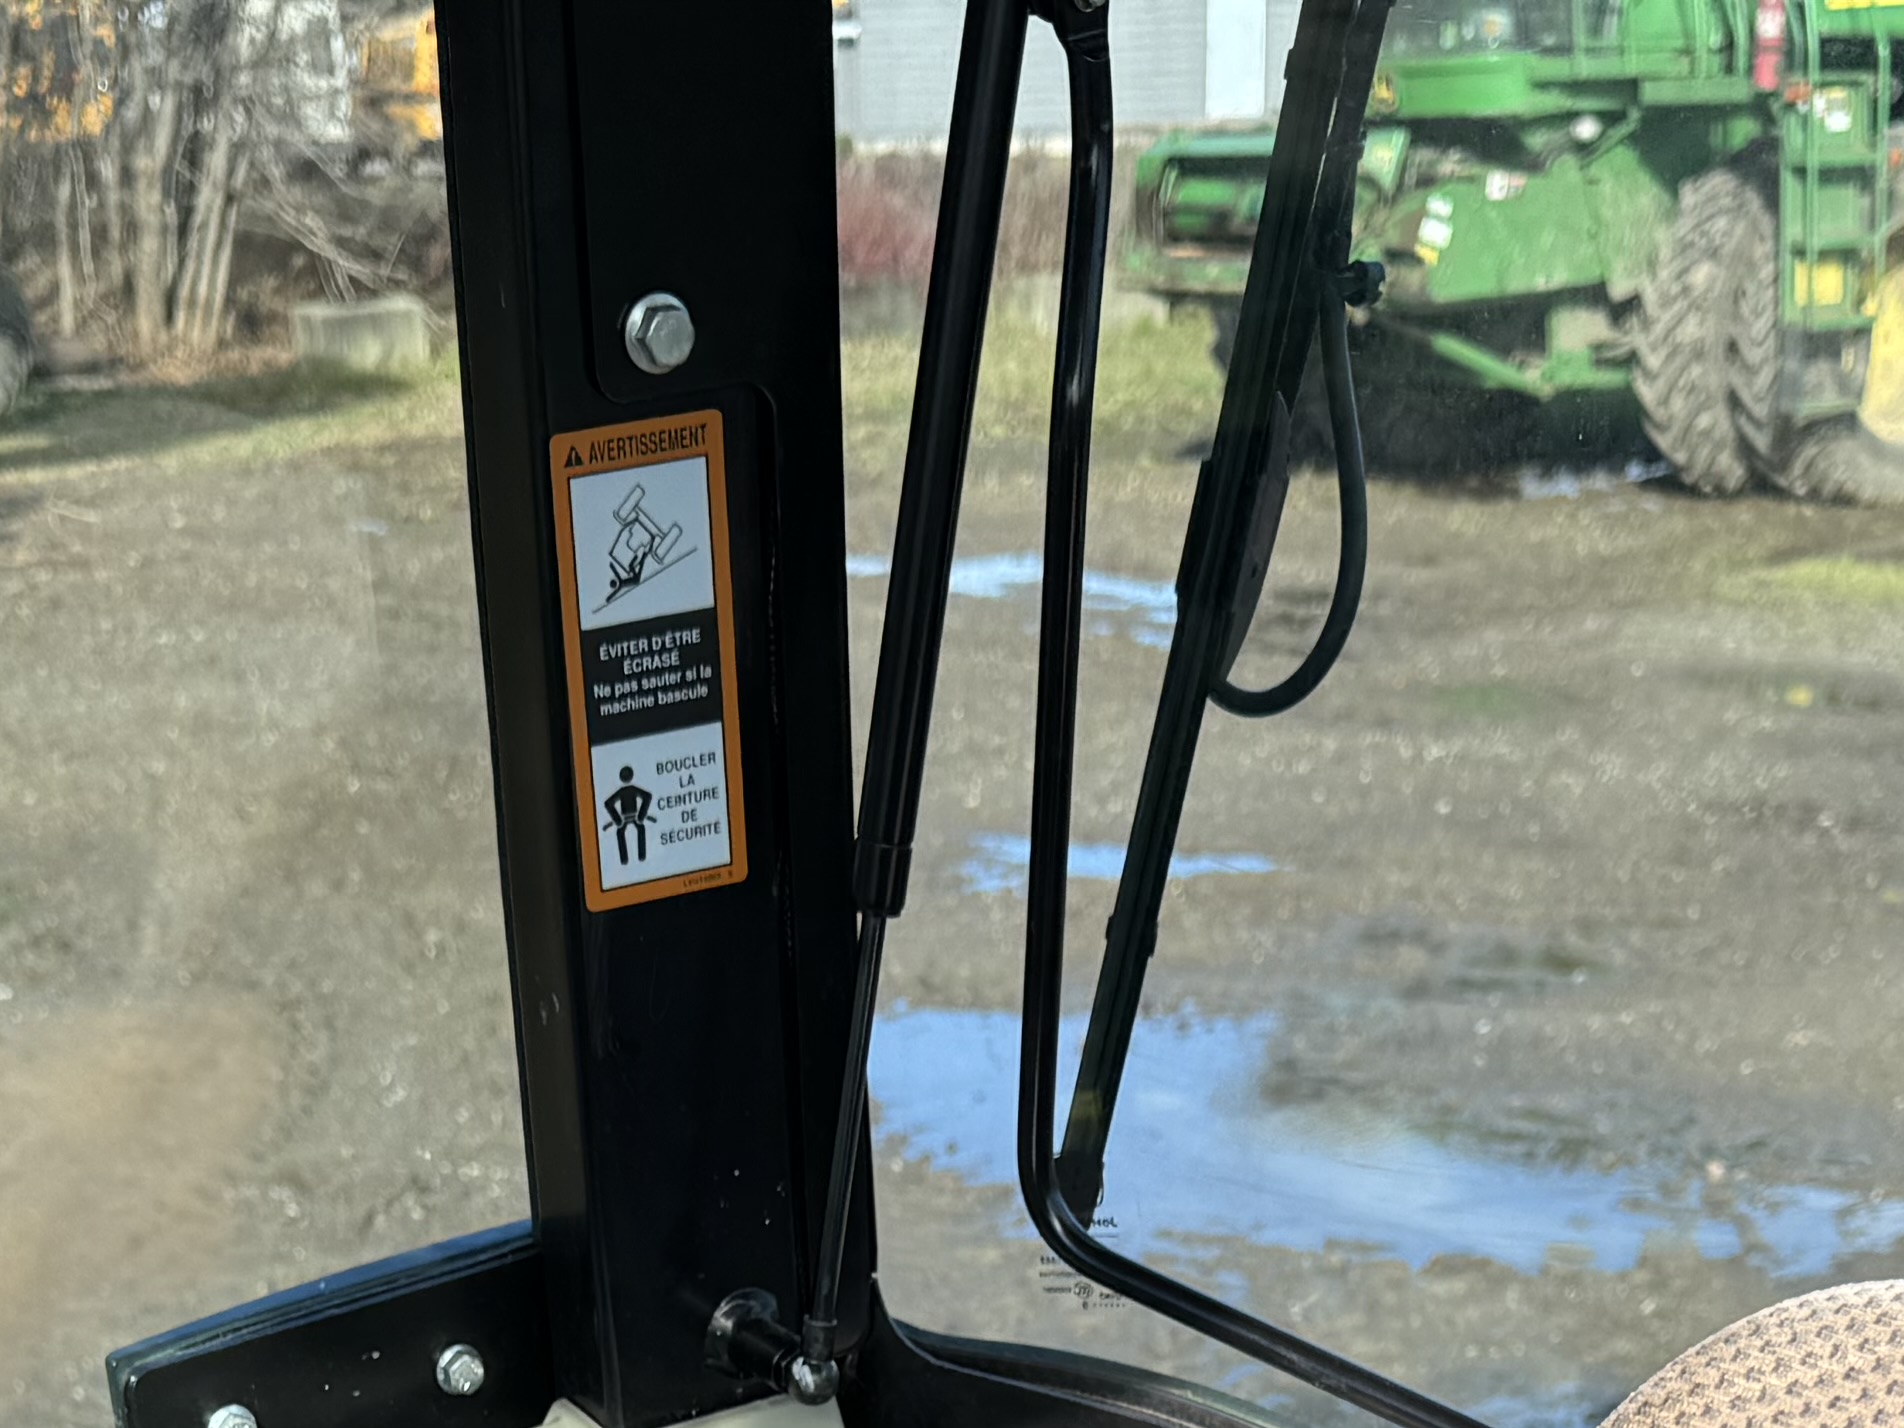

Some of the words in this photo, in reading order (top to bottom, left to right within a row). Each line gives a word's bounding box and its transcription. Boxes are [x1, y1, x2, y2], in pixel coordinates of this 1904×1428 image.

[589, 423, 708, 465] AVERTISSEMENT
[599, 638, 649, 661] ÉVITER
[652, 627, 702, 652] D'ÊTRE
[623, 648, 681, 676] ÉCRASÉ
[593, 684, 612, 699] Ne
[614, 680, 639, 699] pas
[641, 671, 682, 691] sauter
[685, 666, 697, 682] si
[699, 664, 712, 679] la
[600, 695, 655, 716] machine
[657, 683, 709, 705] bascule
[656, 752, 716, 775] BOUCLER
[679, 774, 696, 789] LA
[657, 786, 719, 811] CEINTURE
[681, 809, 698, 824] DE
[660, 819, 722, 846] SÉCURITÉ
